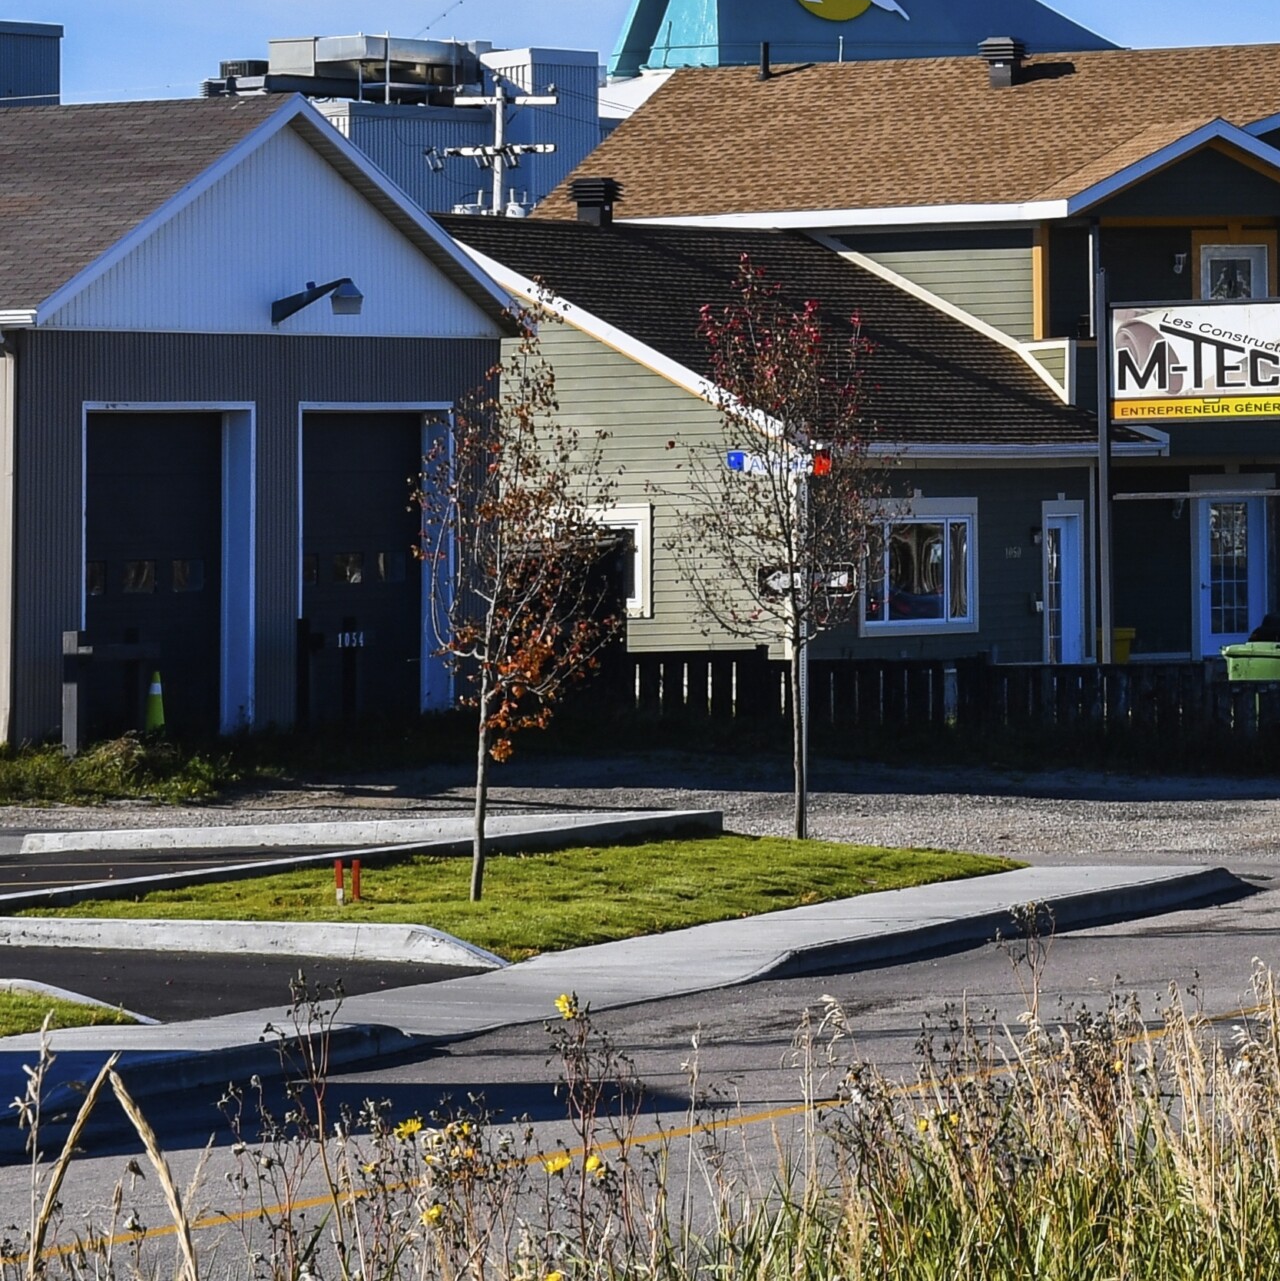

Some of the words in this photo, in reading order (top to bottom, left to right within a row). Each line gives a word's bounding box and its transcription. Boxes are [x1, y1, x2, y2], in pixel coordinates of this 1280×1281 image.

[1161, 312, 1193, 329] Les
[1120, 403, 1231, 417] ENTREPRENEUR
[337, 631, 364, 648] 1054
